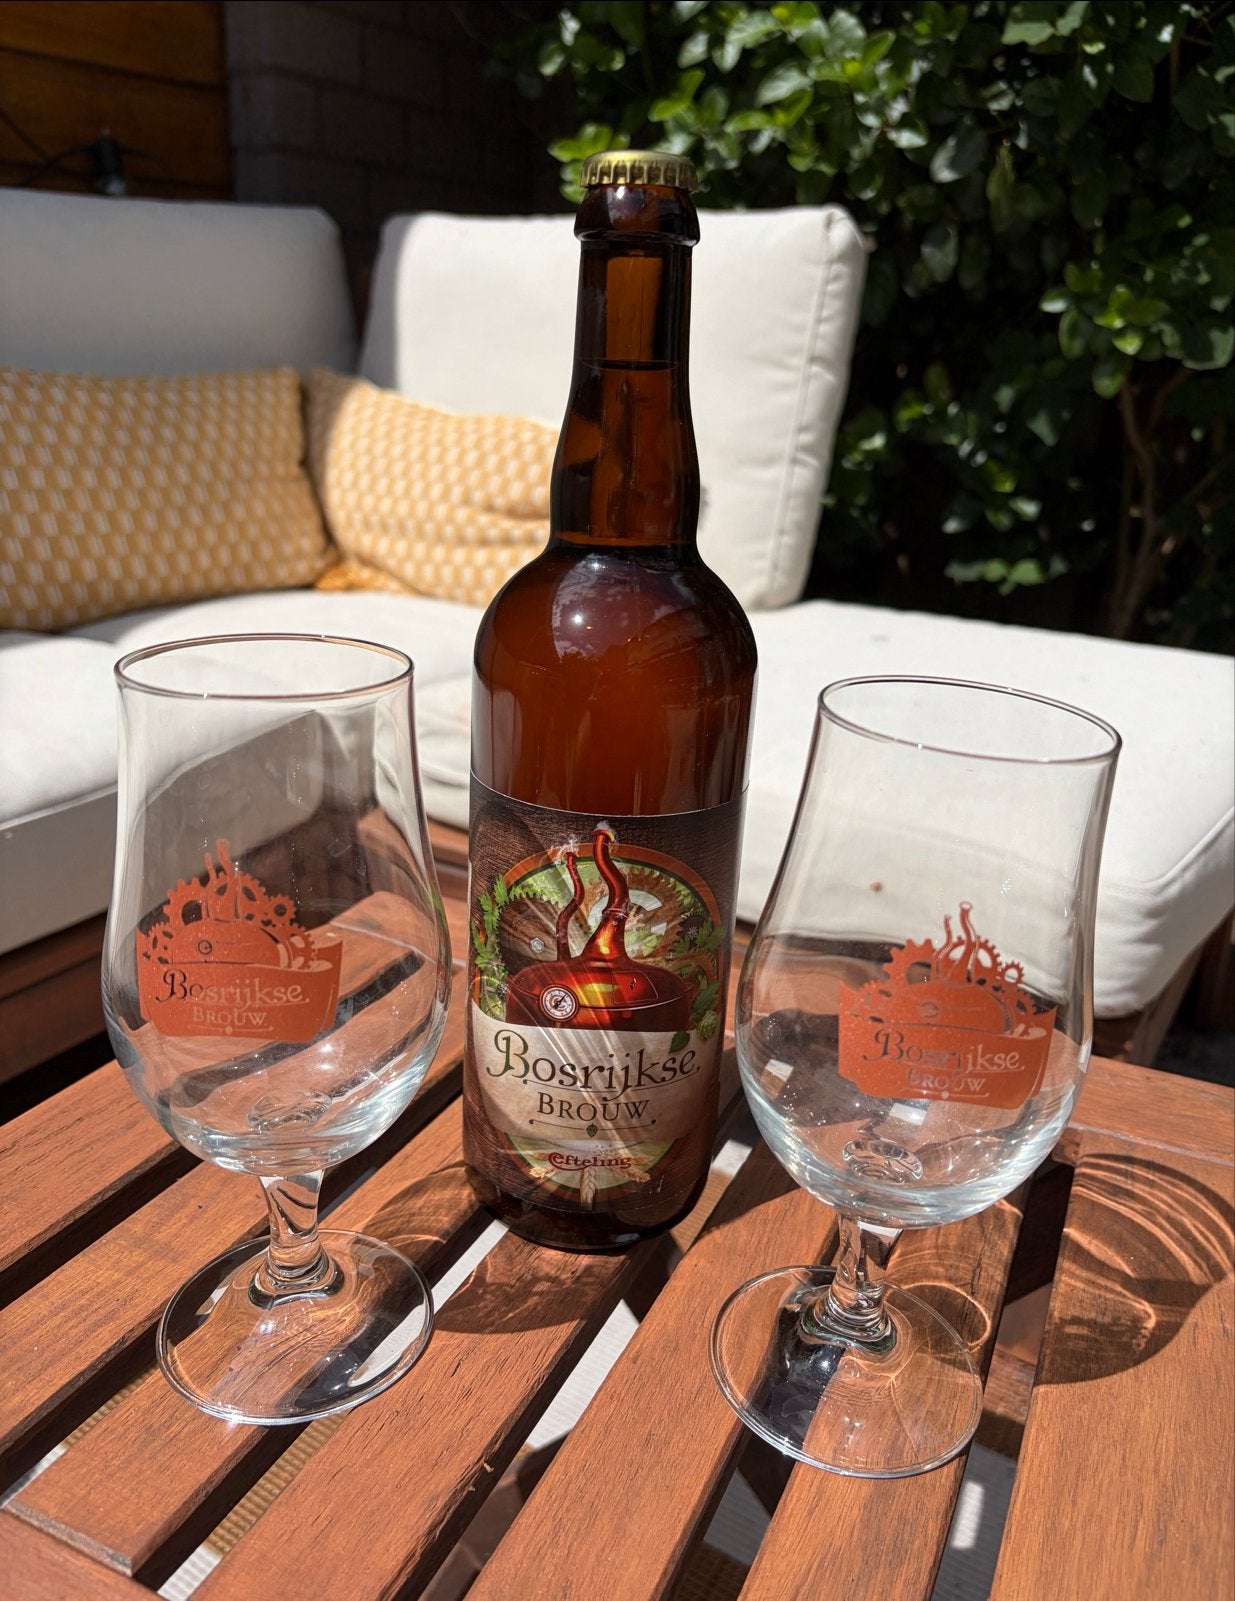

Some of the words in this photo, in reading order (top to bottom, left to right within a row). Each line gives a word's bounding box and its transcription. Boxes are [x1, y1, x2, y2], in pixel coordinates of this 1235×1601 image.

[155, 968, 304, 1012] Bosrijkse
[192, 1006, 267, 1026] BROUW
[487, 1029, 700, 1102] Bosrijkse
[863, 1028, 1020, 1073] Bosrijkse
[906, 1068, 986, 1092] BROUW
[537, 1091, 650, 1122] BROUW
